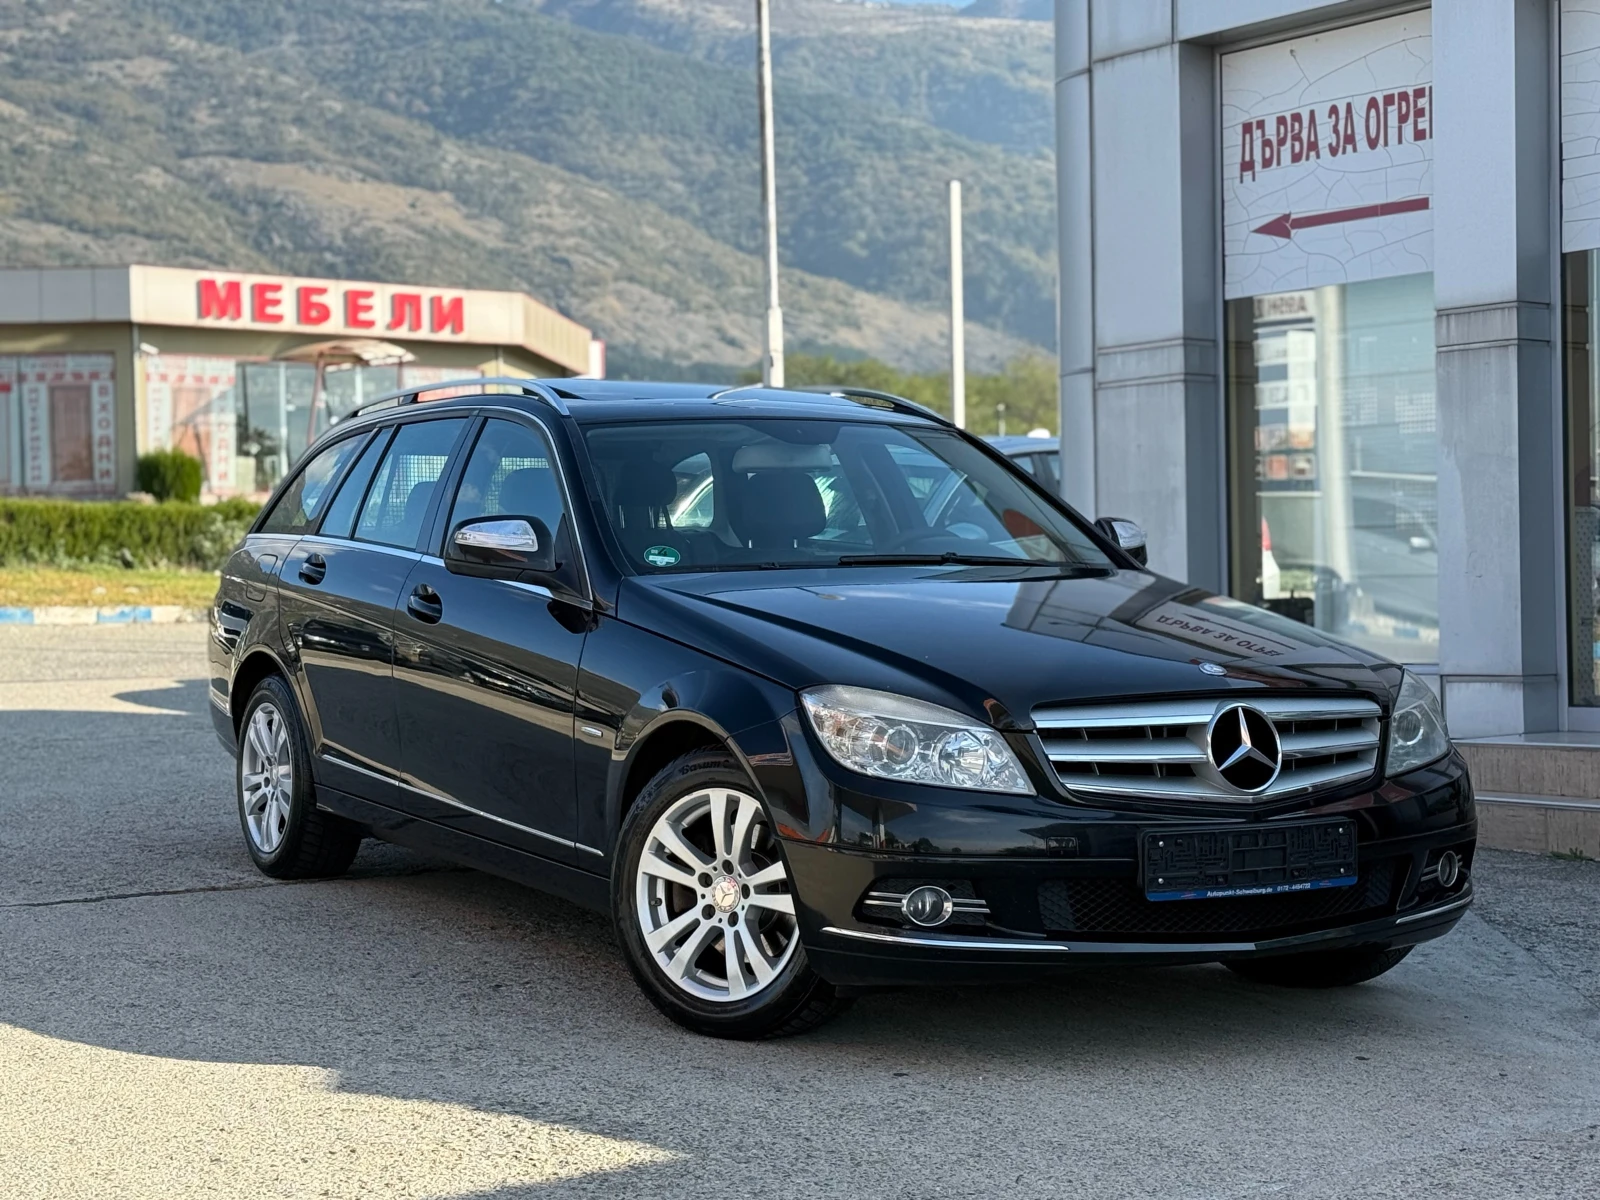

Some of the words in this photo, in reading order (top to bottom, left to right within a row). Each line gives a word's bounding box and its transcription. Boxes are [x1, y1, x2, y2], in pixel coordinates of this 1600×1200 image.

[1240, 109, 1320, 184] ДЪРВА
[1328, 102, 1357, 158] ЗА
[197, 279, 464, 334] МЕБЕЛИ
